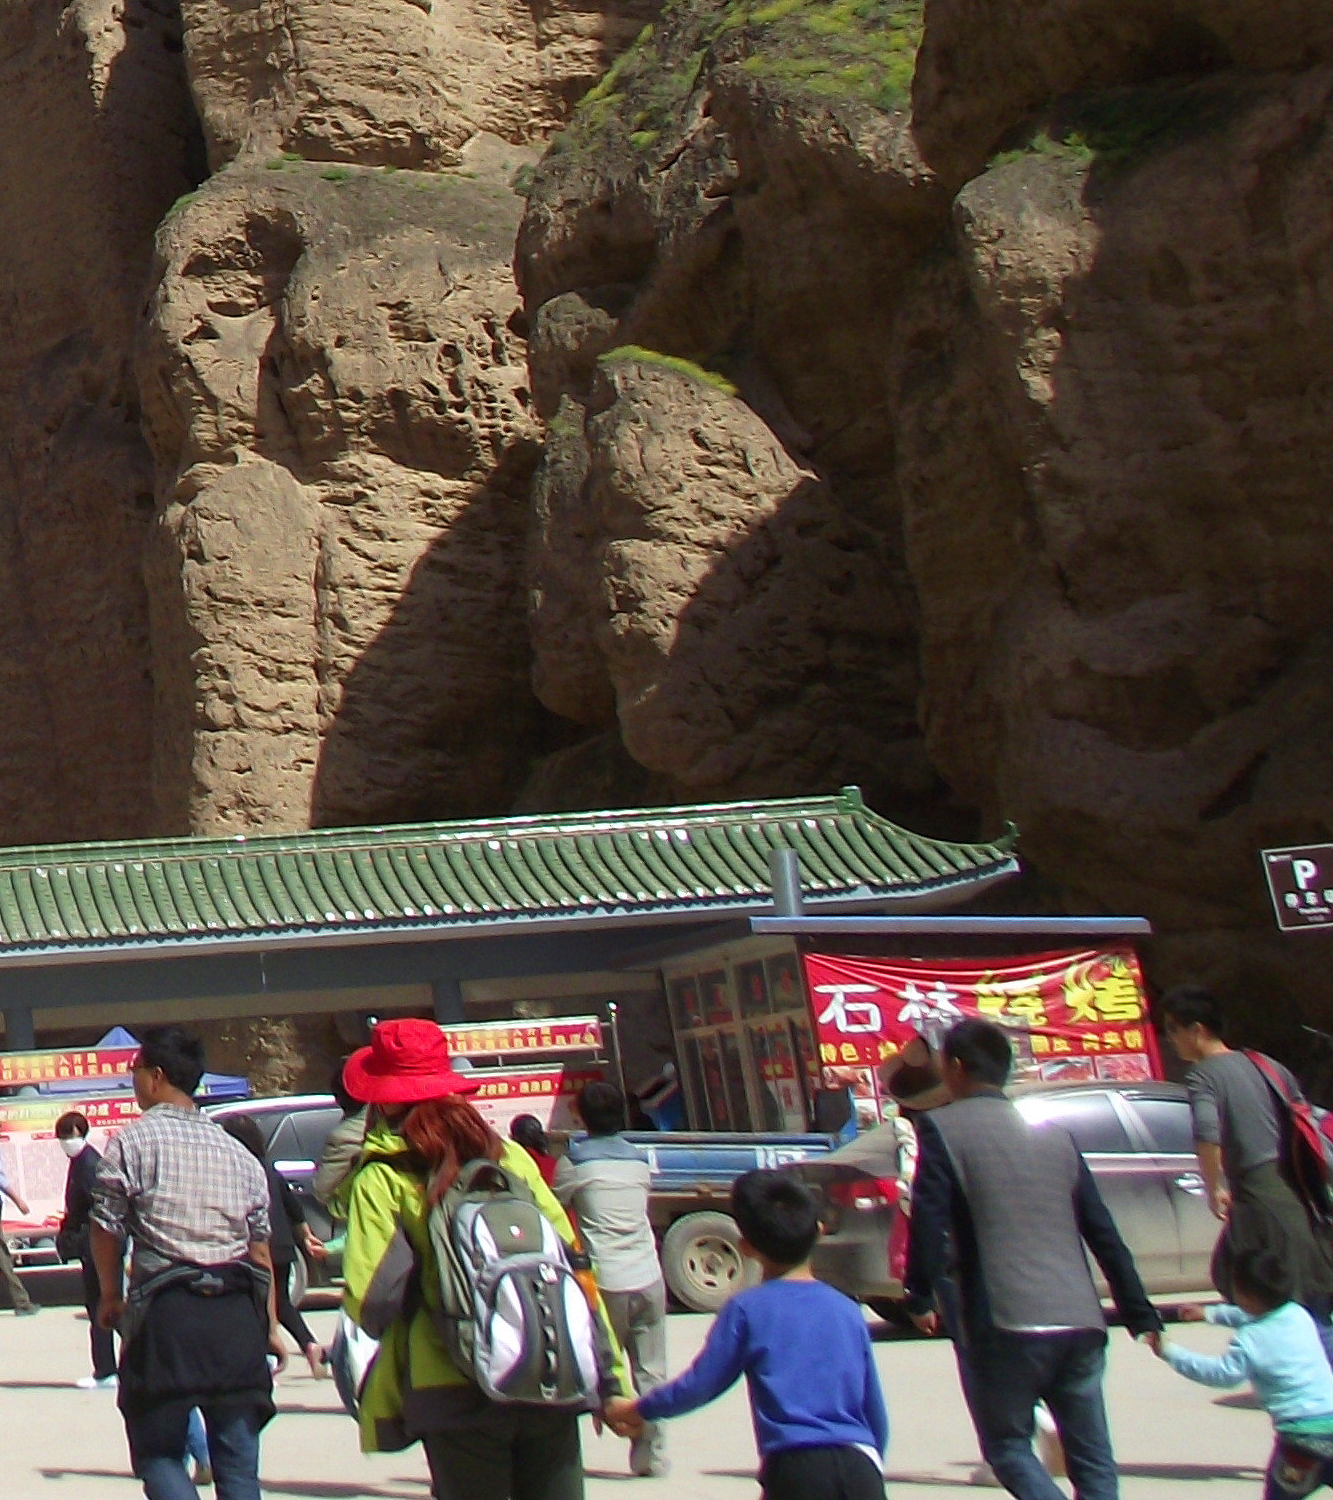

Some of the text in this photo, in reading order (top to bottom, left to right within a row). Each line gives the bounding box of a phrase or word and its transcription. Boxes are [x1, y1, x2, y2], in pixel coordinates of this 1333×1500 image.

[1293, 859, 1316, 890] P
[813, 955, 1143, 1036] 石林烧烤
